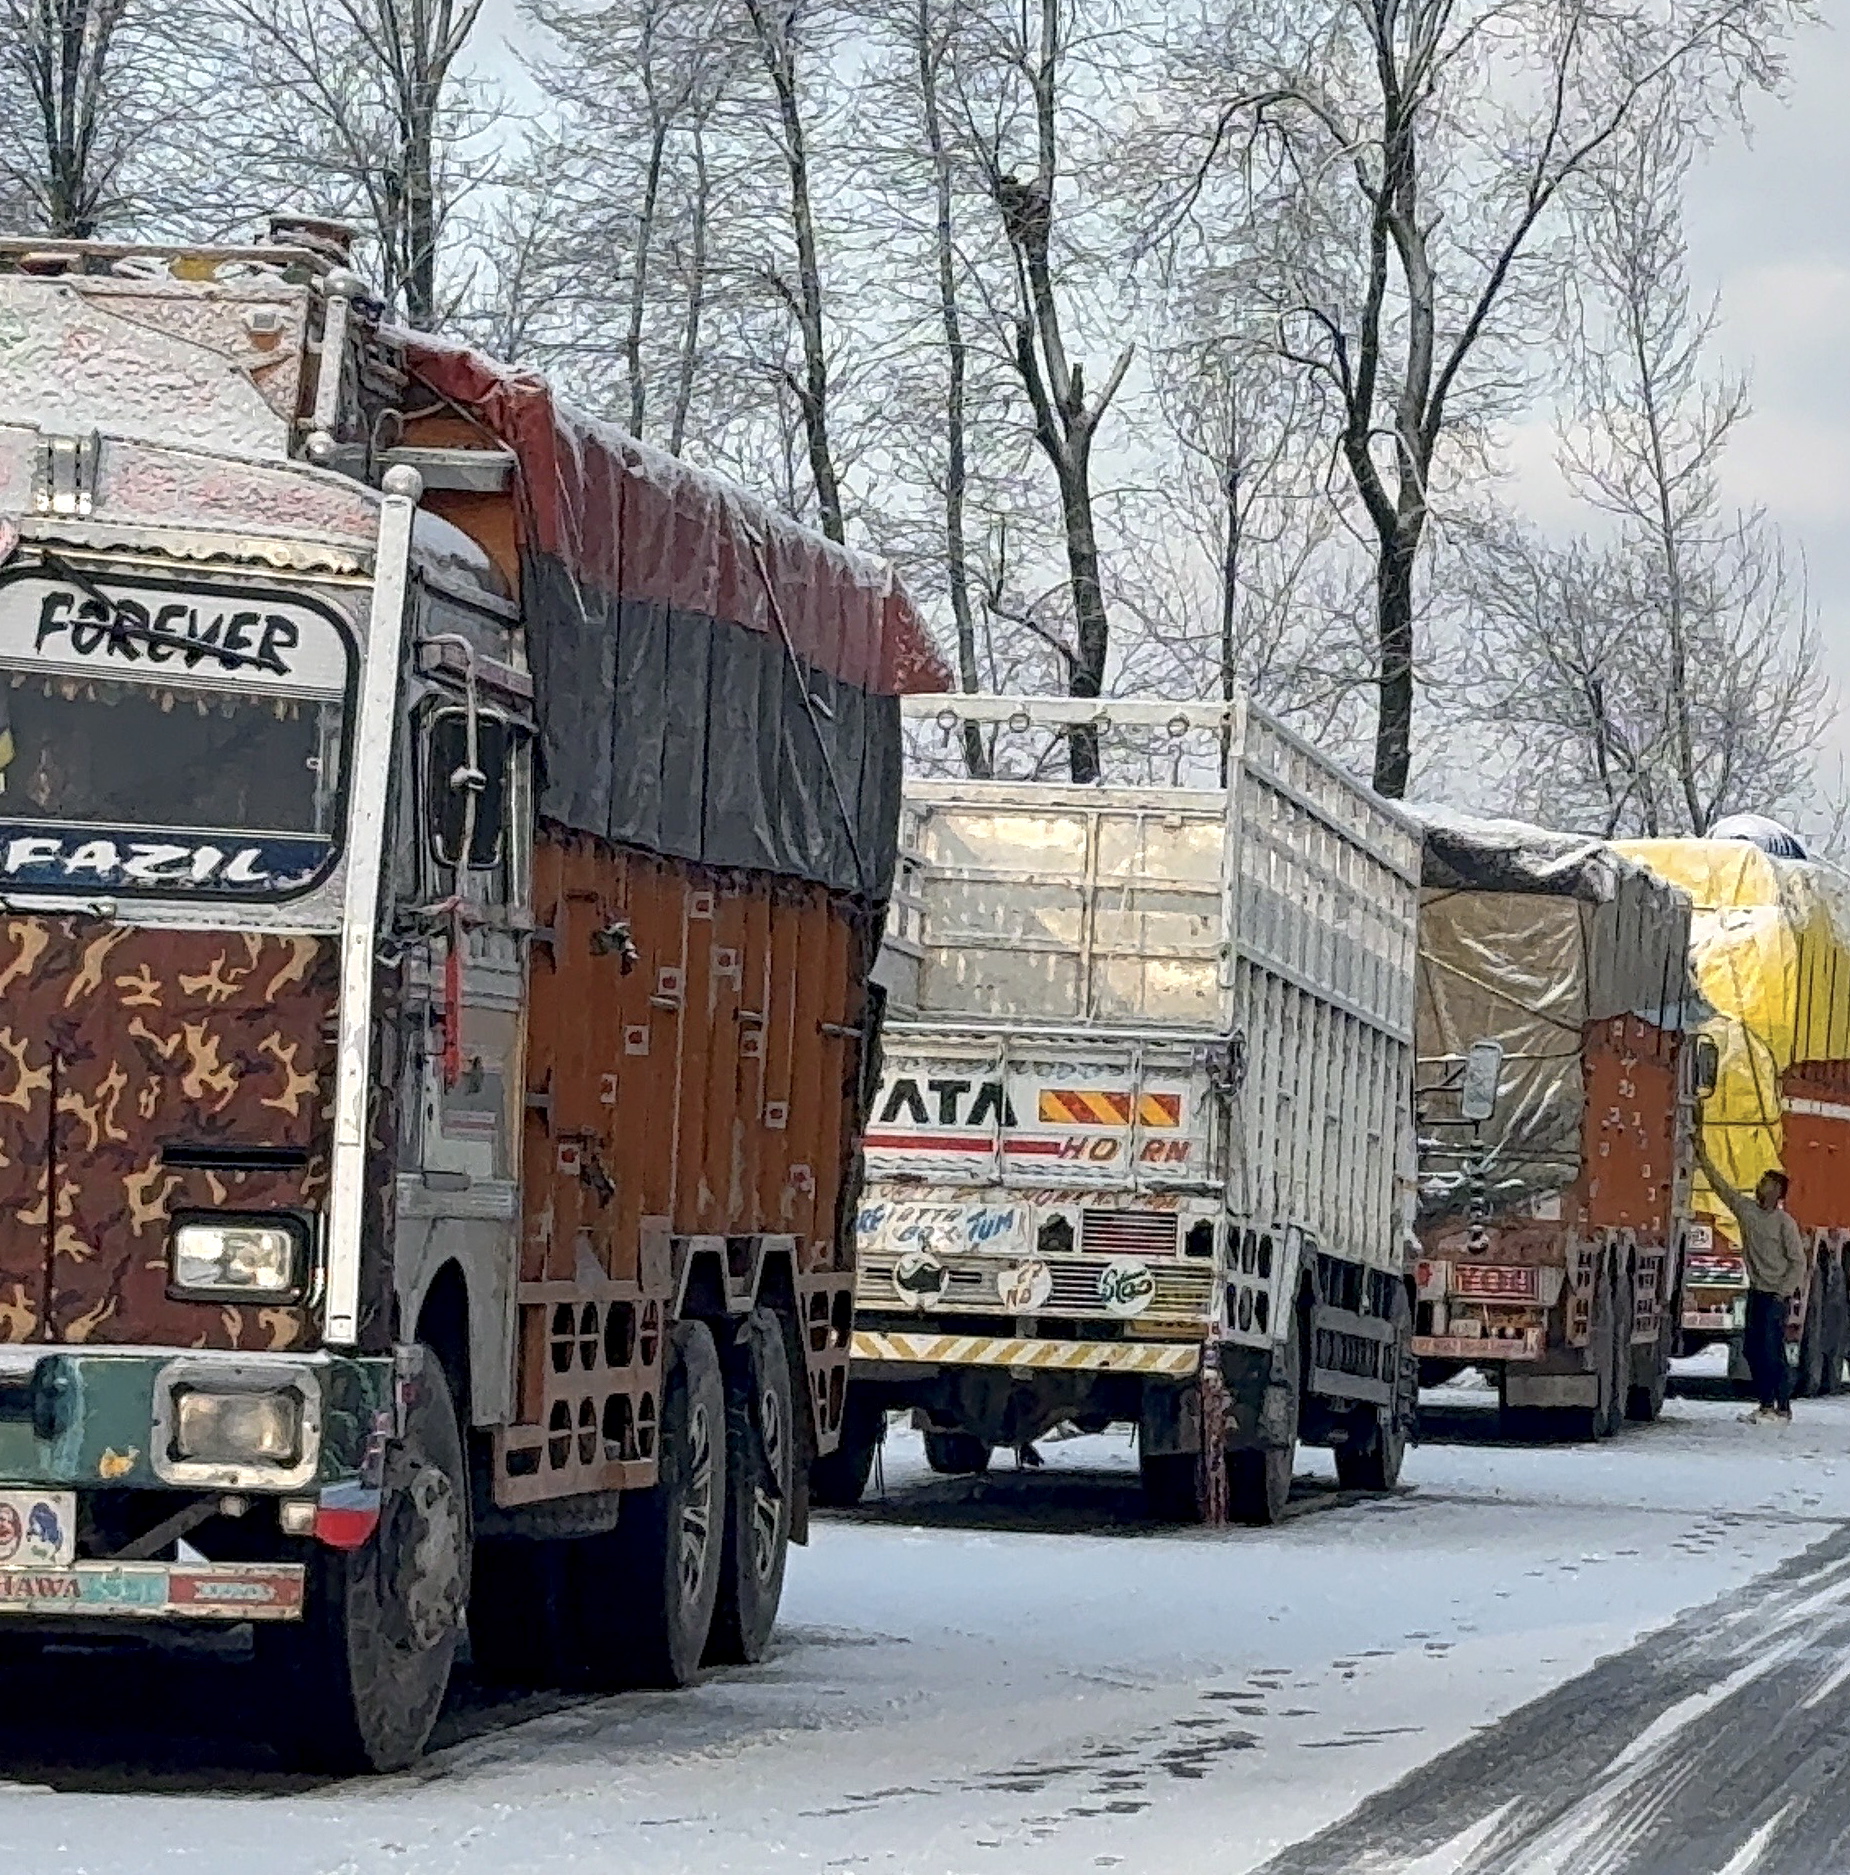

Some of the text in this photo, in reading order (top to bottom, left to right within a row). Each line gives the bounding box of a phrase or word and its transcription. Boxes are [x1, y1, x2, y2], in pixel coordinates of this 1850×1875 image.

[35, 591, 300, 676] FOREVER
[3, 836, 272, 883] FAZIL
[879, 1078, 1018, 1128] ATA
[1058, 1136, 1193, 1163] HORN
